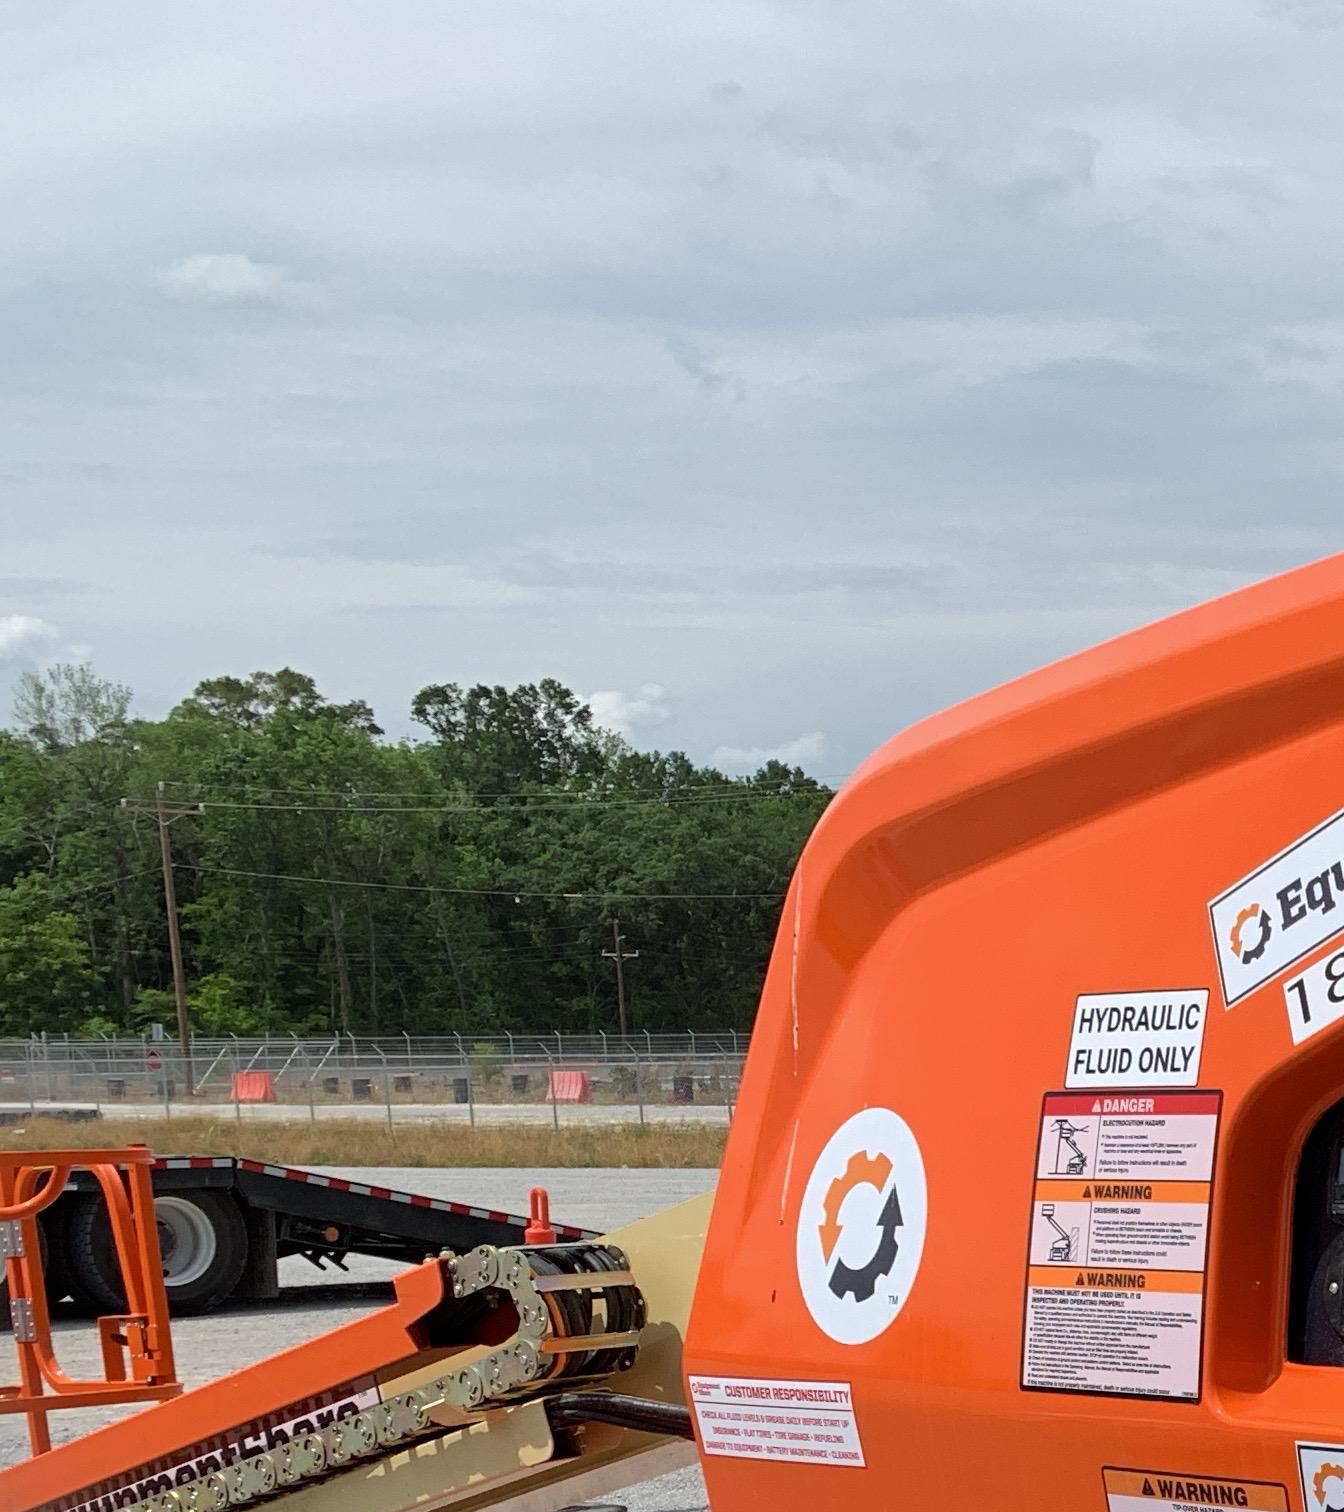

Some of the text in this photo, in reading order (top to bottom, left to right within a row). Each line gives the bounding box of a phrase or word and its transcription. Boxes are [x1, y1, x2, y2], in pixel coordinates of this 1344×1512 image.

[1078, 1003, 1200, 1035] HYDRAULIC
[1073, 1046, 1196, 1075] FLUID ONLY
[1102, 1098, 1155, 1113] DANGER
[1093, 1185, 1152, 1200] WARNING
[1087, 1272, 1146, 1289] WARNING
[724, 1385, 772, 1400] CUSTOMER
[772, 1387, 849, 1405] RESPONSIBILITY
[1157, 1479, 1249, 1507] WARNING
